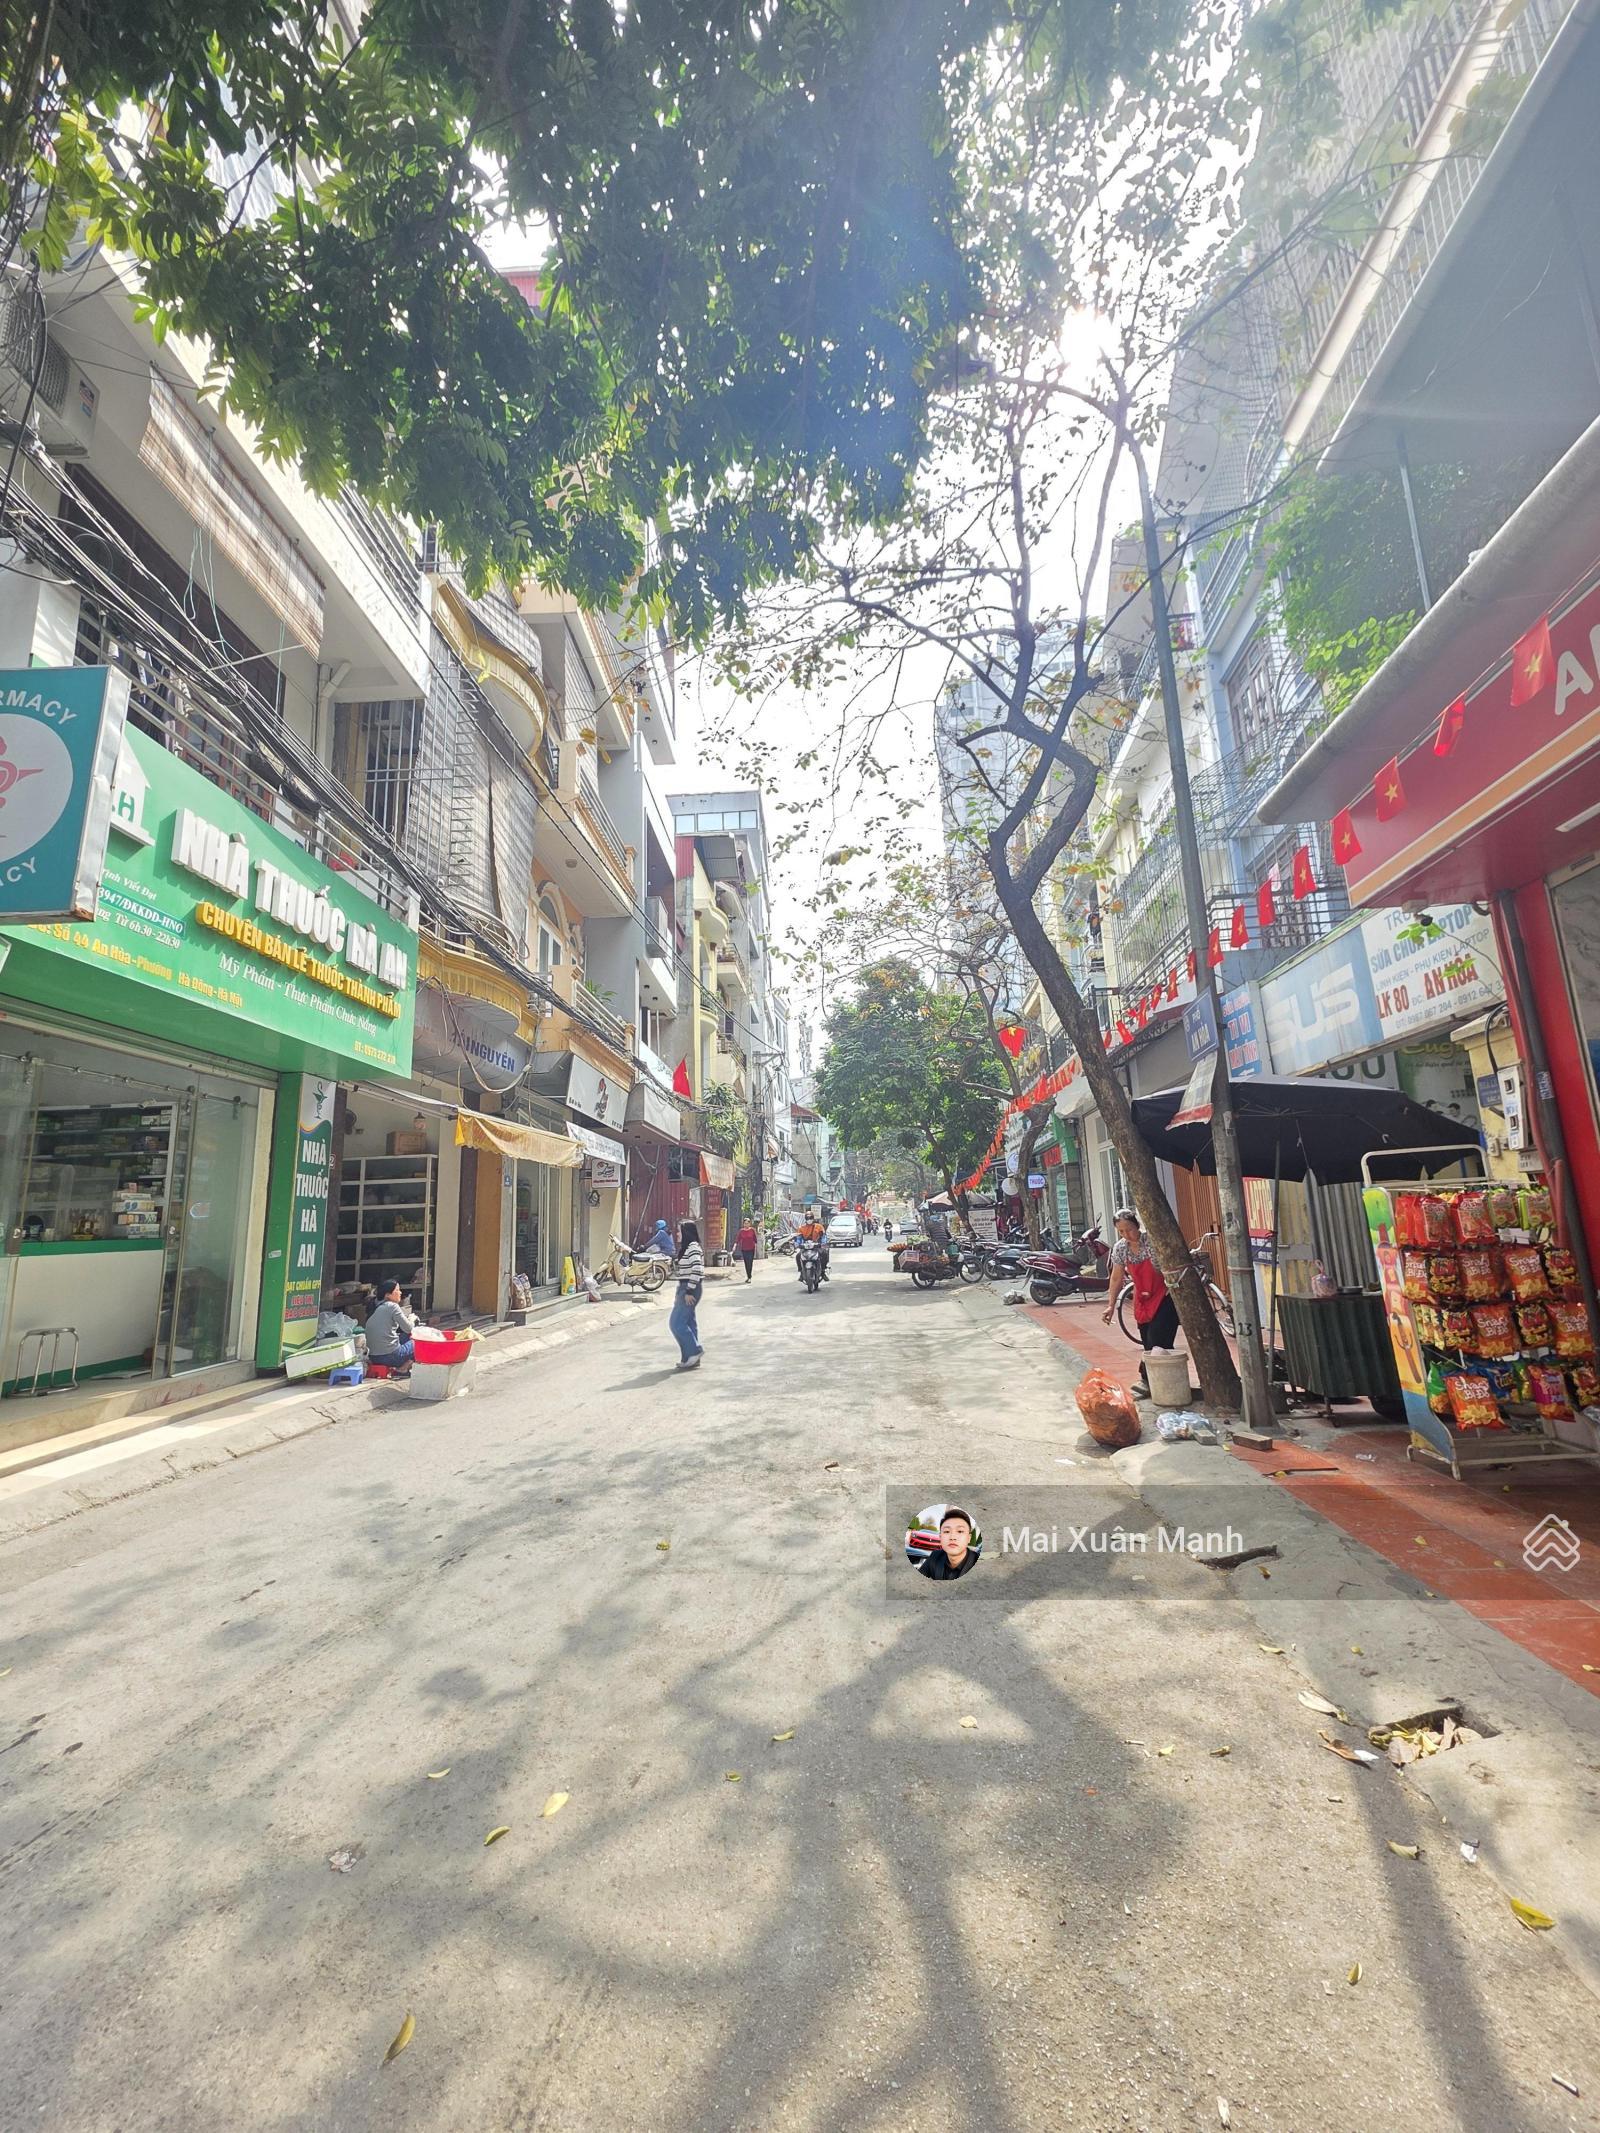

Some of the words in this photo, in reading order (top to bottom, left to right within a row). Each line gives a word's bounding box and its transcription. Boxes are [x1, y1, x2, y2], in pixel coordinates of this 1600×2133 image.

[171, 808, 249, 900] NHÀ
[254, 858, 346, 953] THUỐC
[346, 922, 377, 976] HÀ
[378, 942, 408, 991] AN
[92, 938, 109, 956] An
[196, 900, 262, 951] CHUYÊN
[264, 934, 291, 967] BÁN
[309, 957, 345, 992] THUỐC
[1454, 928, 1490, 955] LAPTOP
[219, 952, 240, 977] Mỹ
[1393, 984, 1410, 1013] 80
[1424, 968, 1446, 1000] AN
[302, 1139, 327, 1166] NHÀ
[296, 1169, 329, 1200] THUỐC
[300, 1205, 317, 1233] HÀ
[297, 1243, 316, 1268] AN
